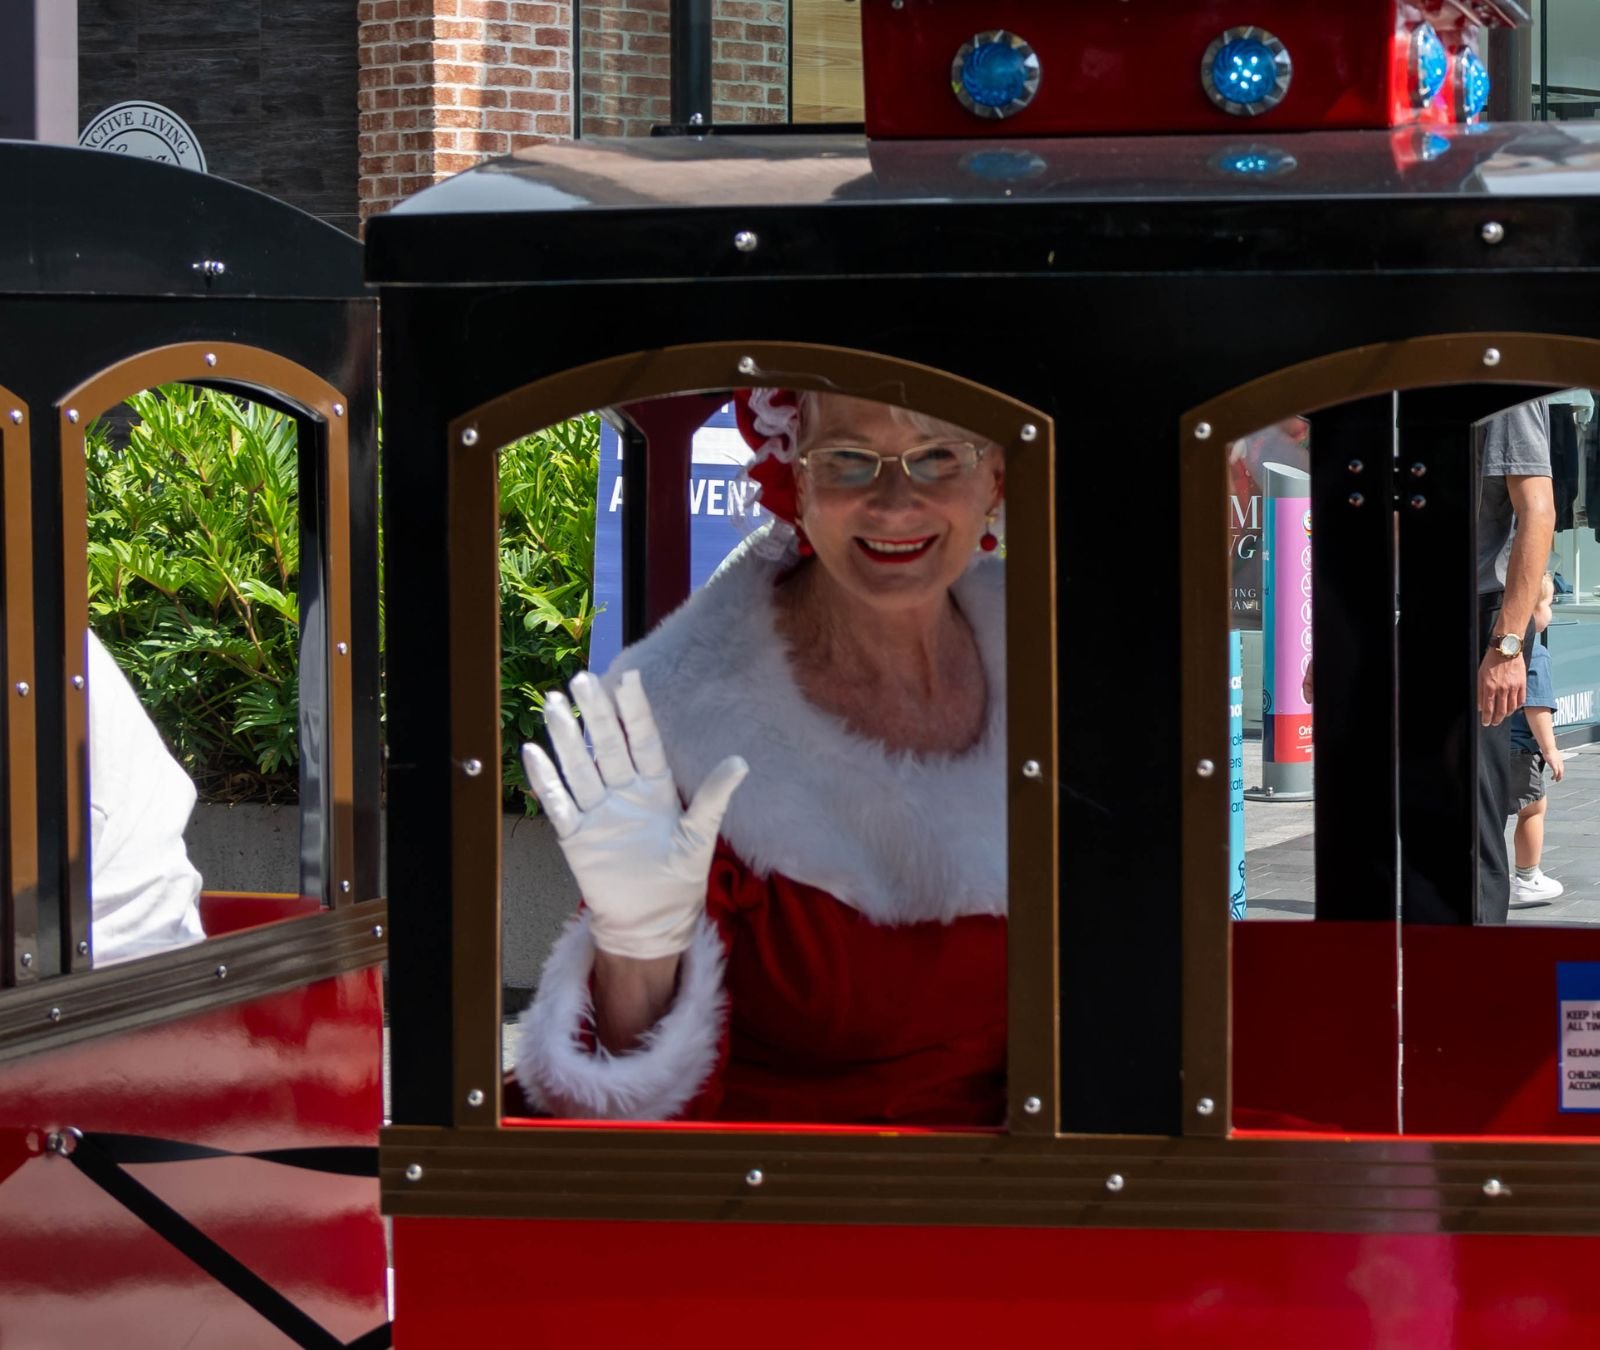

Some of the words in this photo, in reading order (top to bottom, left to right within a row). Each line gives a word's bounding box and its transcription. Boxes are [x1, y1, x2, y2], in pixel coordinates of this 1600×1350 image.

[141, 112, 189, 155] LIVING
[1567, 1010, 1590, 1020] KEEP
[1567, 1022, 1584, 1031] ALL
